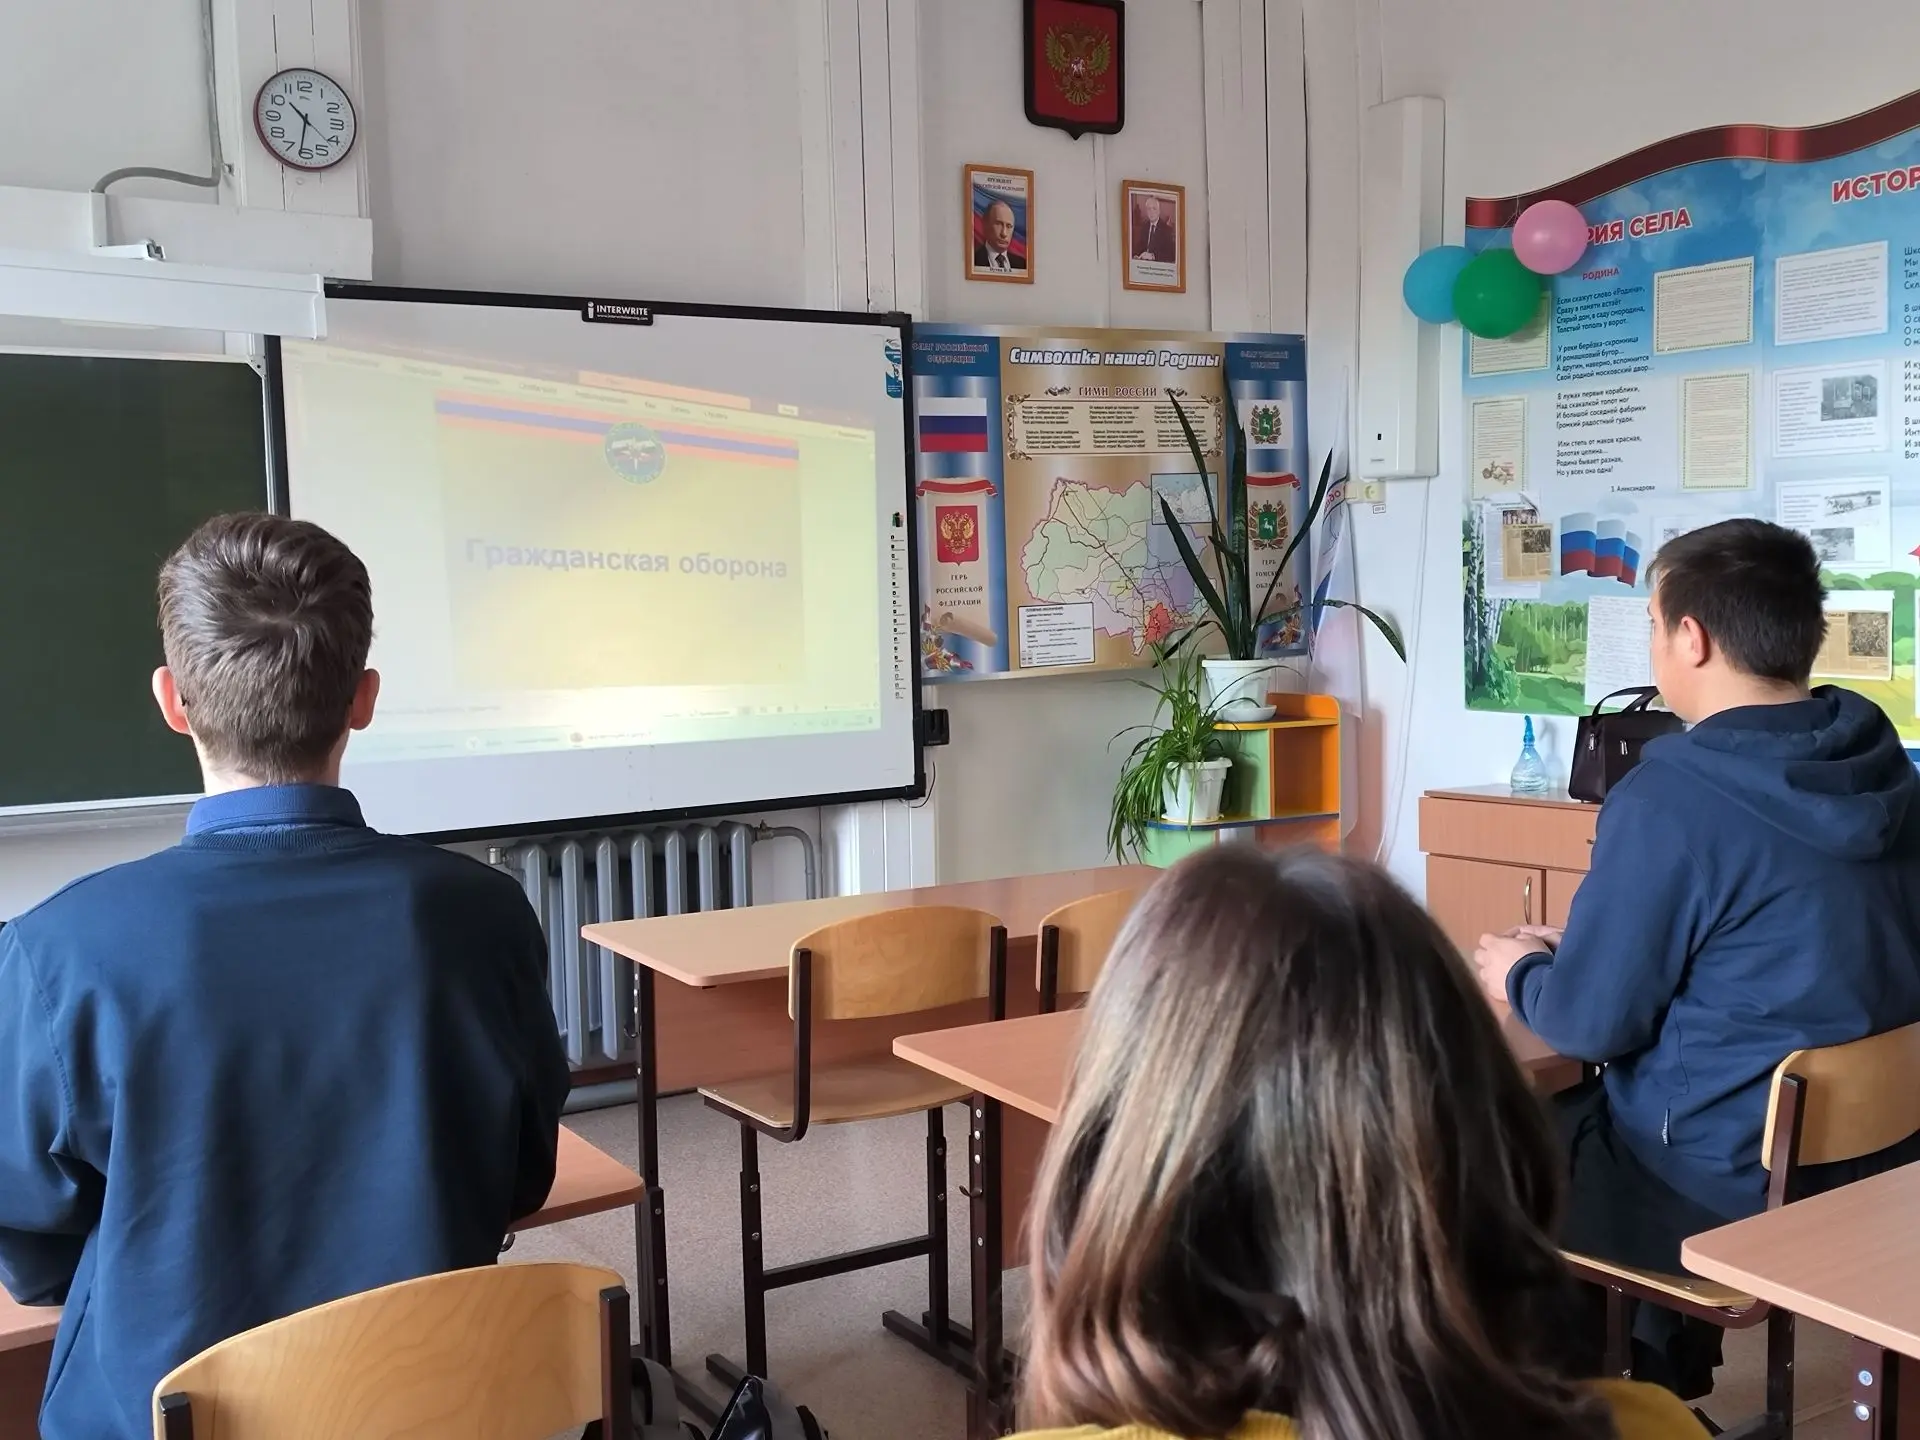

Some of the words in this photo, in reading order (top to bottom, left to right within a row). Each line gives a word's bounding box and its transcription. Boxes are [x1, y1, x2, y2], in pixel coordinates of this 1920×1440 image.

[284, 83, 292, 94] 11
[297, 80, 313, 93] 12
[271, 94, 285, 106] 10
[326, 102, 340, 114] 2
[265, 110, 281, 121] 9
[330, 118, 344, 131] 3
[271, 126, 285, 138] 8
[282, 140, 295, 151] 7
[327, 135, 340, 146] 4
[299, 148, 313, 160] 6
[315, 144, 328, 157] 5
[1629, 207, 1692, 238] СЕЛА
[1904, 258, 1919, 267] Мы
[1582, 266, 1620, 280] РОДИНА
[1904, 269, 1919, 279] Там
[1557, 297, 1571, 305] Если
[1572, 294, 1593, 304] скажут
[597, 305, 648, 316] INTERWRITE
[1557, 306, 1574, 315] Сразу
[1580, 303, 1600, 312] памяти
[1904, 303, 1910, 312] В
[1557, 315, 1577, 325] Старый
[1597, 311, 1609, 319] саду
[1904, 315, 1911, 324] О
[1557, 323, 1580, 333] Толстый
[1582, 321, 1602, 330] тополь
[1904, 326, 1912, 335] О
[1904, 337, 1912, 347] О
[1564, 344, 1577, 352] реки
[1010, 347, 1100, 366] Символика
[1104, 351, 1155, 366] нашей
[1159, 351, 1220, 369] Родины
[1563, 352, 1600, 363] ромашковый
[1586, 360, 1612, 368] наверно,
[1613, 355, 1649, 365] вспомнится
[1904, 360, 1911, 369] И
[1557, 373, 1571, 381] Свой
[1572, 370, 1594, 380] родной
[1596, 366, 1631, 376] московский
[1904, 371, 1911, 380] И
[1079, 387, 1109, 396] ГИМН
[1115, 387, 1157, 397] РОССИИ
[1904, 382, 1911, 392] И
[1563, 391, 1580, 400] лужах
[1582, 390, 1604, 398] первые
[1605, 386, 1640, 395] кораблики,
[1904, 394, 1911, 403] И
[1569, 399, 1599, 408] скакалкой
[1563, 409, 1588, 419] большой
[1590, 406, 1618, 416] соседней
[1619, 405, 1646, 414] фабрики
[1557, 419, 1580, 429] Громкий
[1582, 416, 1614, 427] радостный
[1904, 417, 1910, 426] В
[1904, 439, 1911, 448] И
[1557, 449, 1579, 457] Золотая
[1905, 450, 1919, 460] Вот
[1557, 459, 1577, 467] Родина
[466, 537, 670, 572] Гражданская
[679, 552, 787, 580] оборона
[936, 586, 983, 594] РОССИЙСКОЙ
[938, 599, 981, 607] ФЕДЕРАЦИИ
